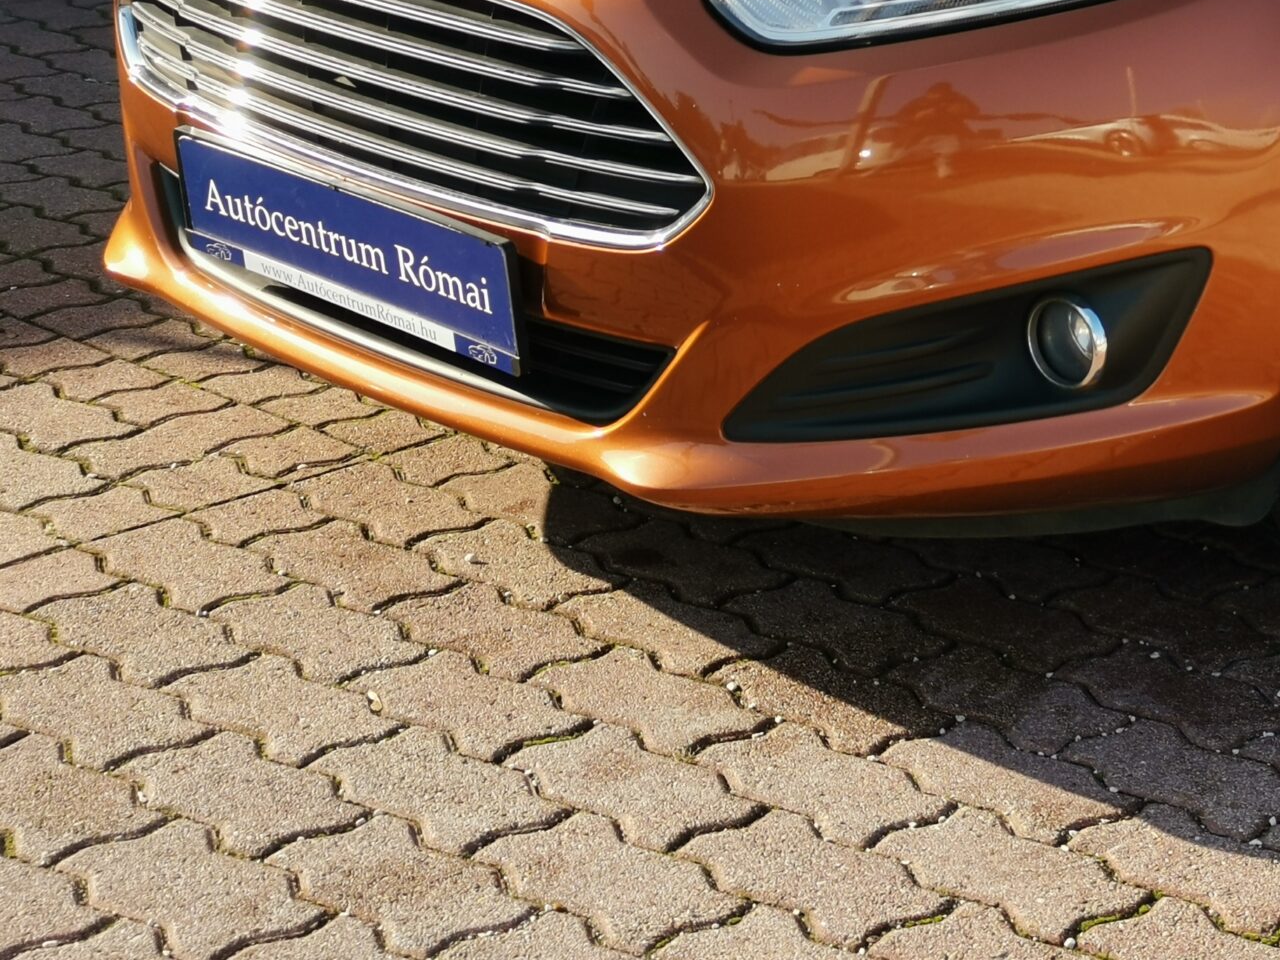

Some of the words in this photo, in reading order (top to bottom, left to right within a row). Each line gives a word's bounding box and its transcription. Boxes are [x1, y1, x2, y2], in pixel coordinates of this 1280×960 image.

[205, 178, 389, 276] Autócentrum
[395, 243, 493, 315] Római
[260, 259, 438, 342] www.AutócentrumRómai.hu
